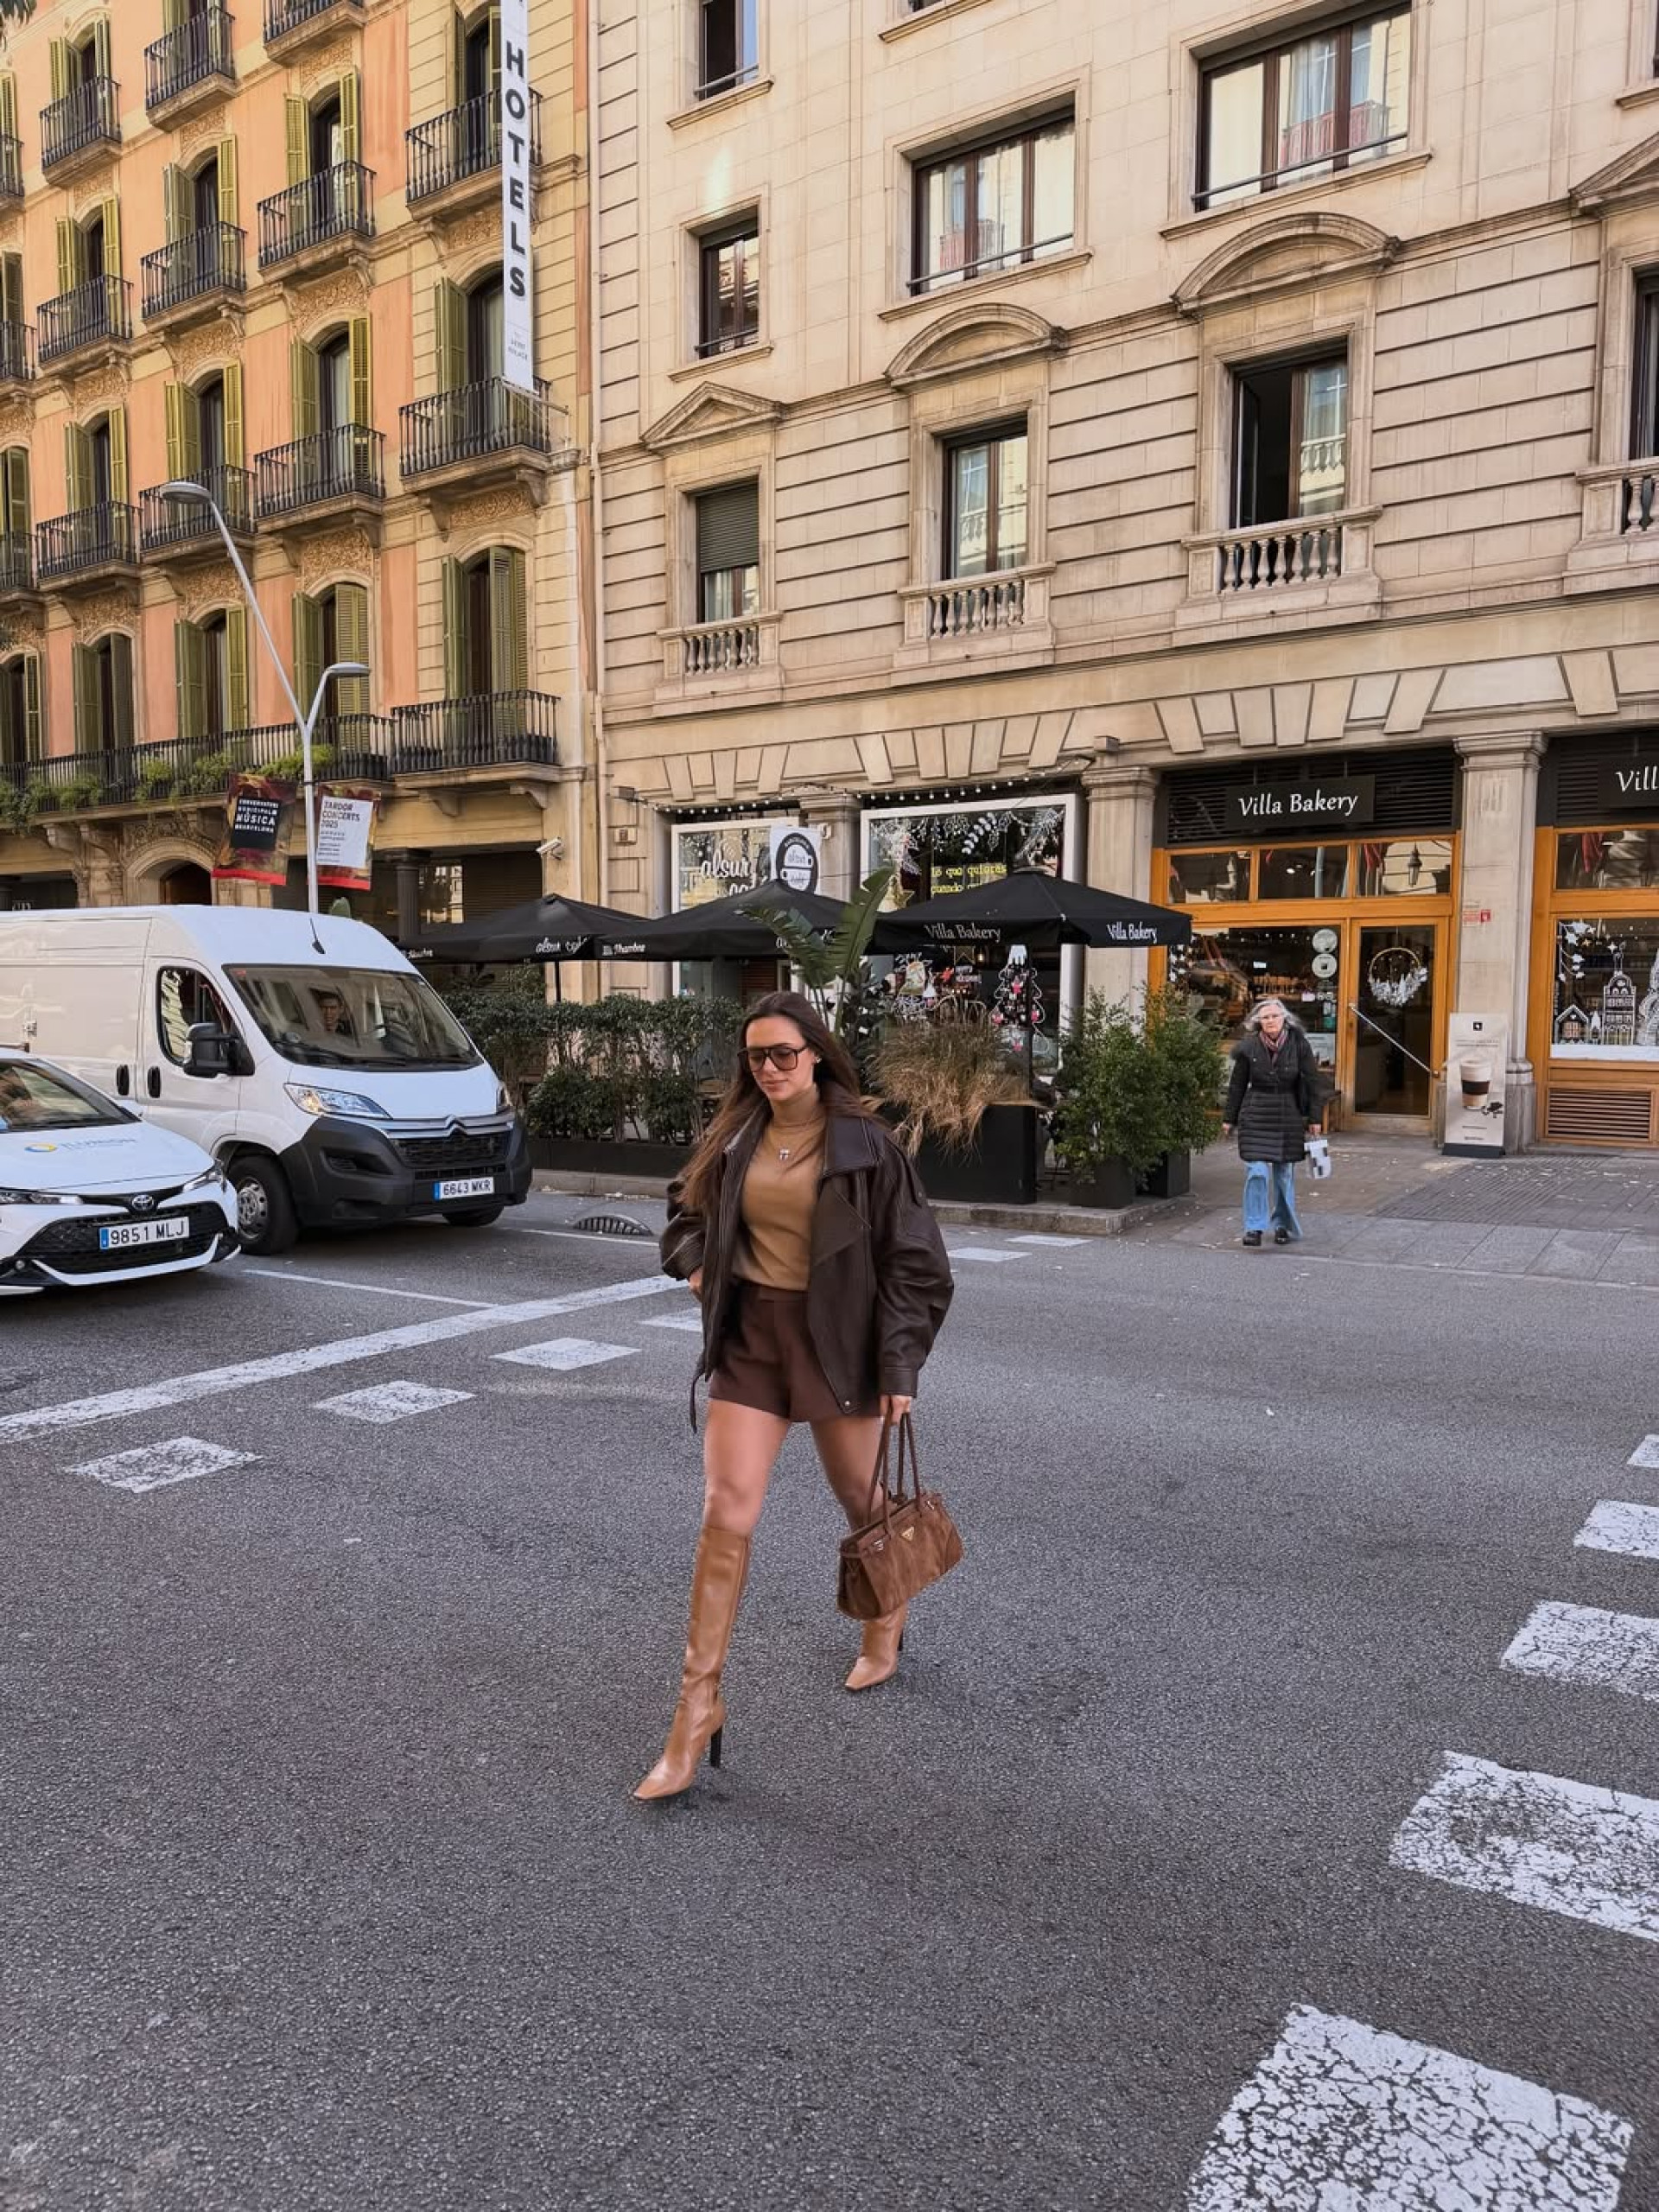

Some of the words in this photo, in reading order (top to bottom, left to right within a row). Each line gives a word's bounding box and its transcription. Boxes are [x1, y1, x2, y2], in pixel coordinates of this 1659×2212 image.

[505, 40, 526, 297] HOTELS
[1615, 766, 1659, 791] Vill
[1237, 792, 1282, 817] Villa
[1289, 788, 1358, 817] Bakery
[236, 812, 276, 826] MÚSICA
[321, 810, 360, 822] CONCERTS
[924, 923, 955, 939] Villa
[956, 925, 1001, 943] Bakery
[1107, 922, 1127, 940] Villa
[1128, 924, 1158, 944] Bakery
[443, 1181, 469, 1196] 6643
[110, 1226, 149, 1245] 9851
[156, 1220, 184, 1239] MLJ
